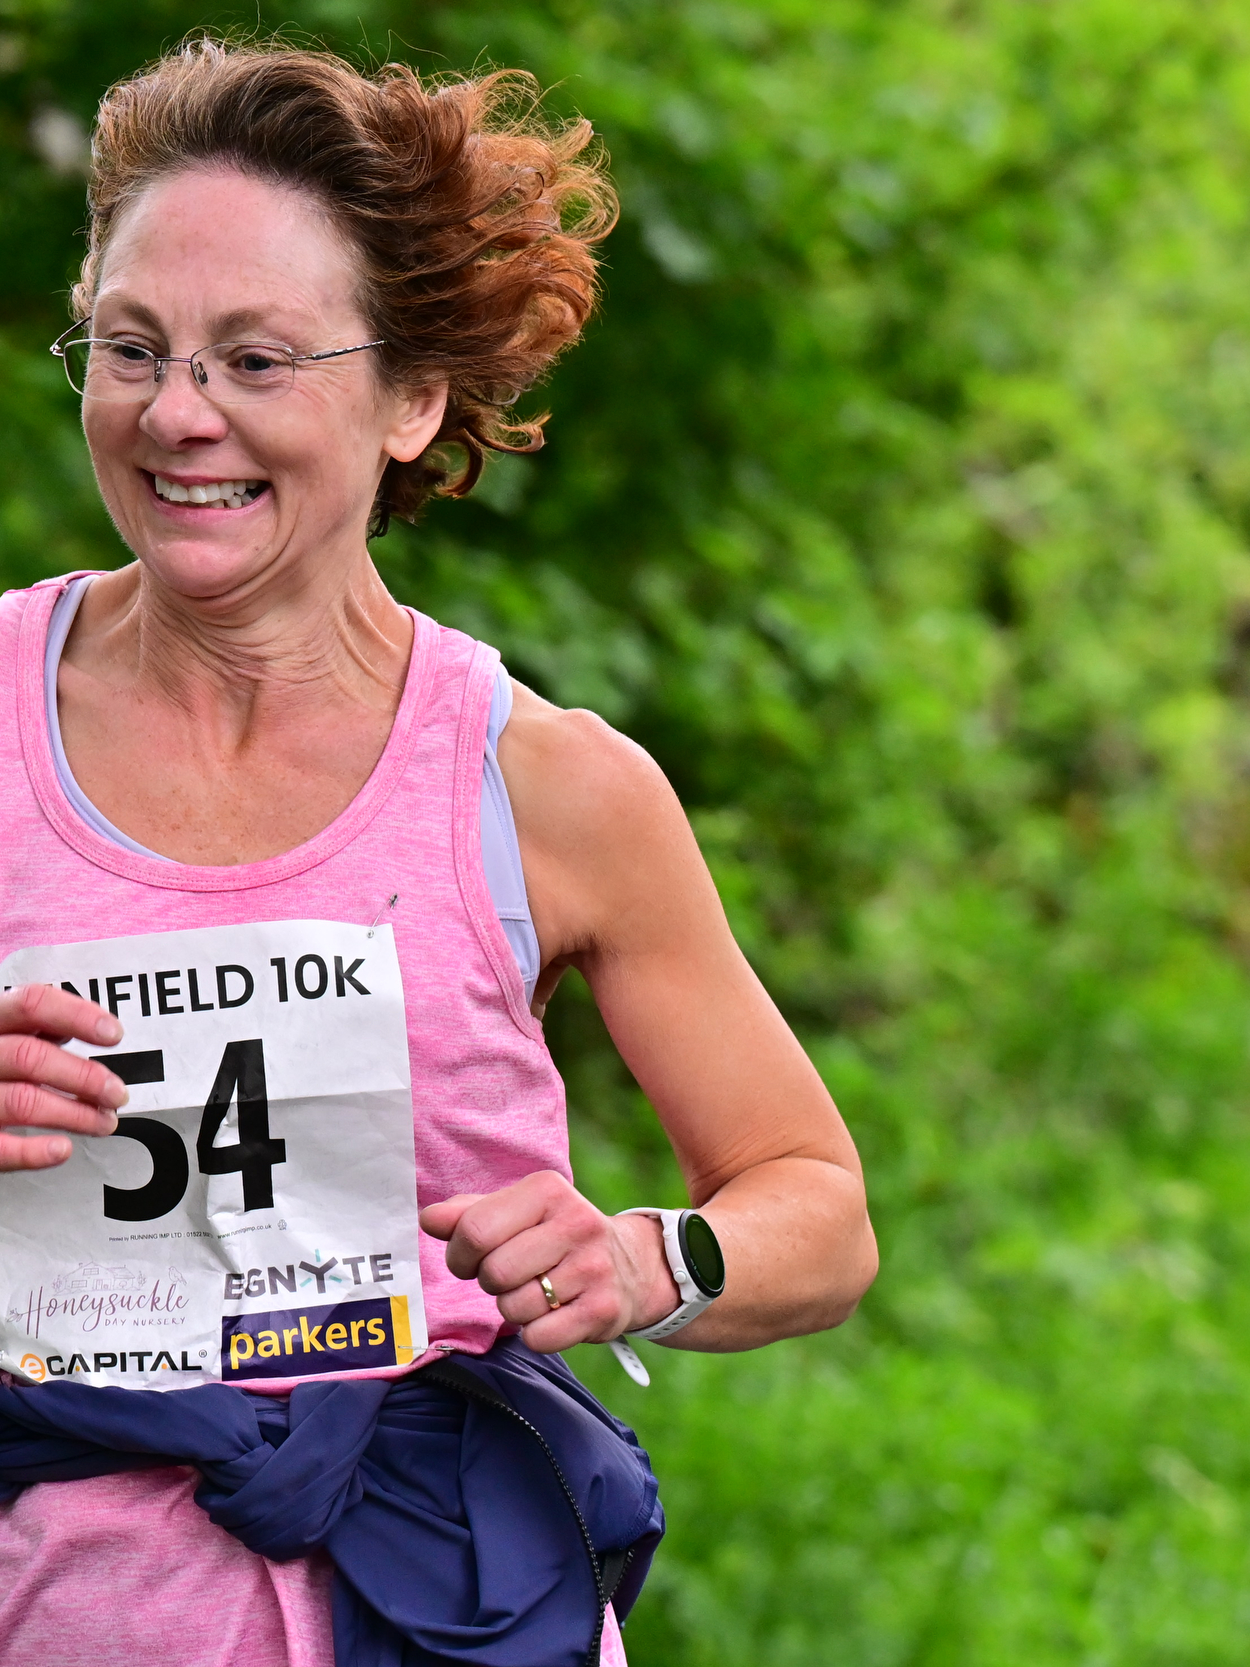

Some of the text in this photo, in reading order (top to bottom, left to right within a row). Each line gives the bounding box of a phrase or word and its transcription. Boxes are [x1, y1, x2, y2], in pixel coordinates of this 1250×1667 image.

[269, 953, 372, 1003] 10K
[88, 1038, 287, 1222] 54
[130, 1233, 158, 1241] RUNNING
[158, 1232, 170, 1240] IMP
[171, 1231, 182, 1239] LTD
[223, 1253, 394, 1300] EGNYTE
[23, 1279, 190, 1339] Honeysuckle
[104, 1316, 186, 1327] DAY NURSERY
[228, 1316, 387, 1370] parkers
